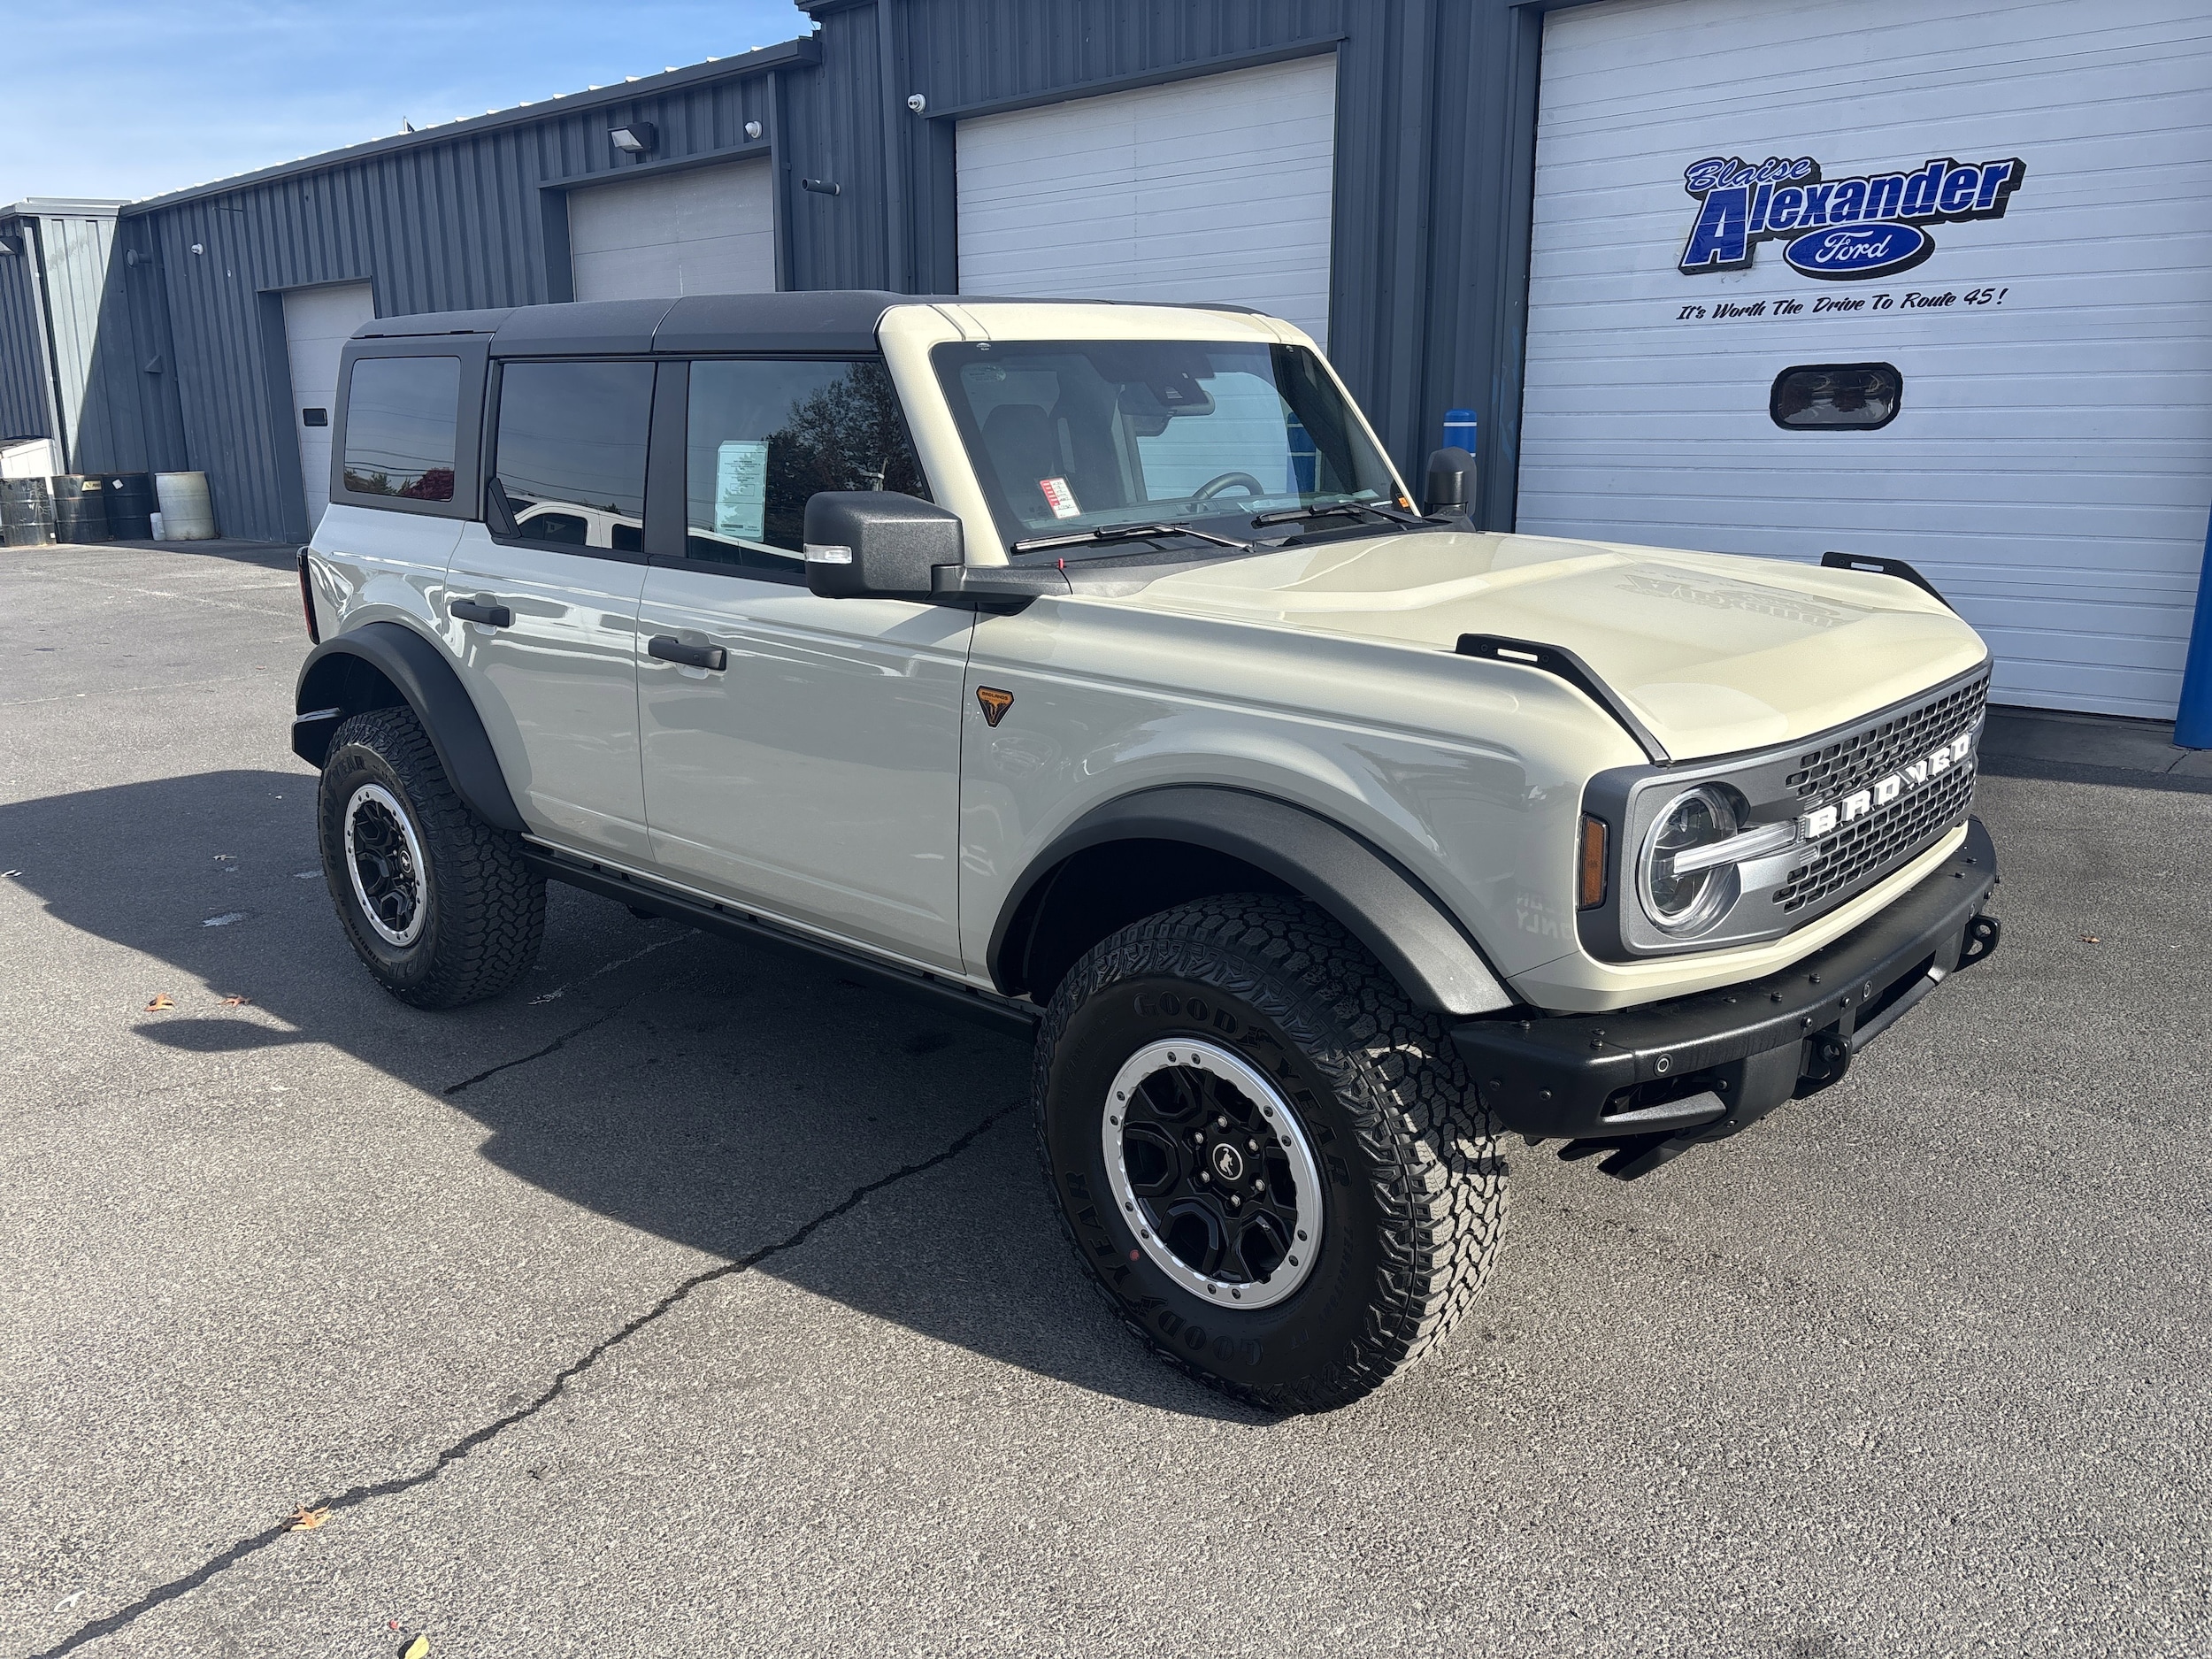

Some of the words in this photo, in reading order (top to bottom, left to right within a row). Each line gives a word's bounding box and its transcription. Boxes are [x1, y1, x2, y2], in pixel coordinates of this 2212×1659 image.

[1686, 157, 1812, 193] Blaise
[1681, 159, 2015, 266] Alexander
[1815, 231, 1892, 263] Ford
[1676, 305, 1706, 320] It's
[1712, 300, 1765, 319] Worth
[1772, 299, 1803, 316] The
[1812, 296, 1864, 313] Drive
[1871, 294, 1893, 311] To
[1900, 291, 1956, 309] Route
